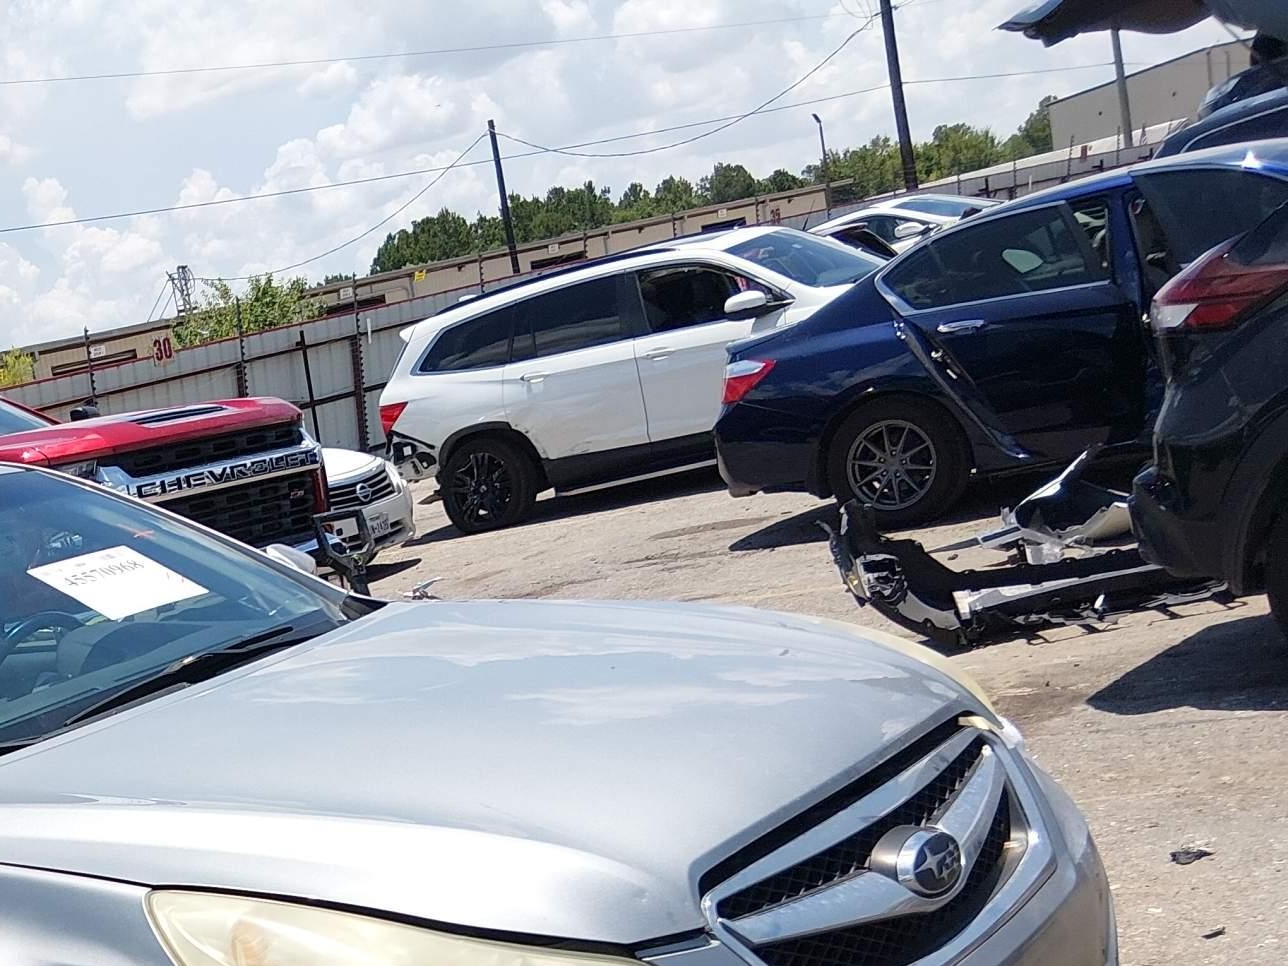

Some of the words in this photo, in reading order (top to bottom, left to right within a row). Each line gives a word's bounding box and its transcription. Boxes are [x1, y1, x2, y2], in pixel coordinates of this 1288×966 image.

[153, 337, 173, 362] 30
[136, 450, 319, 499] CHEVROLET
[64, 559, 145, 587] 45570968
